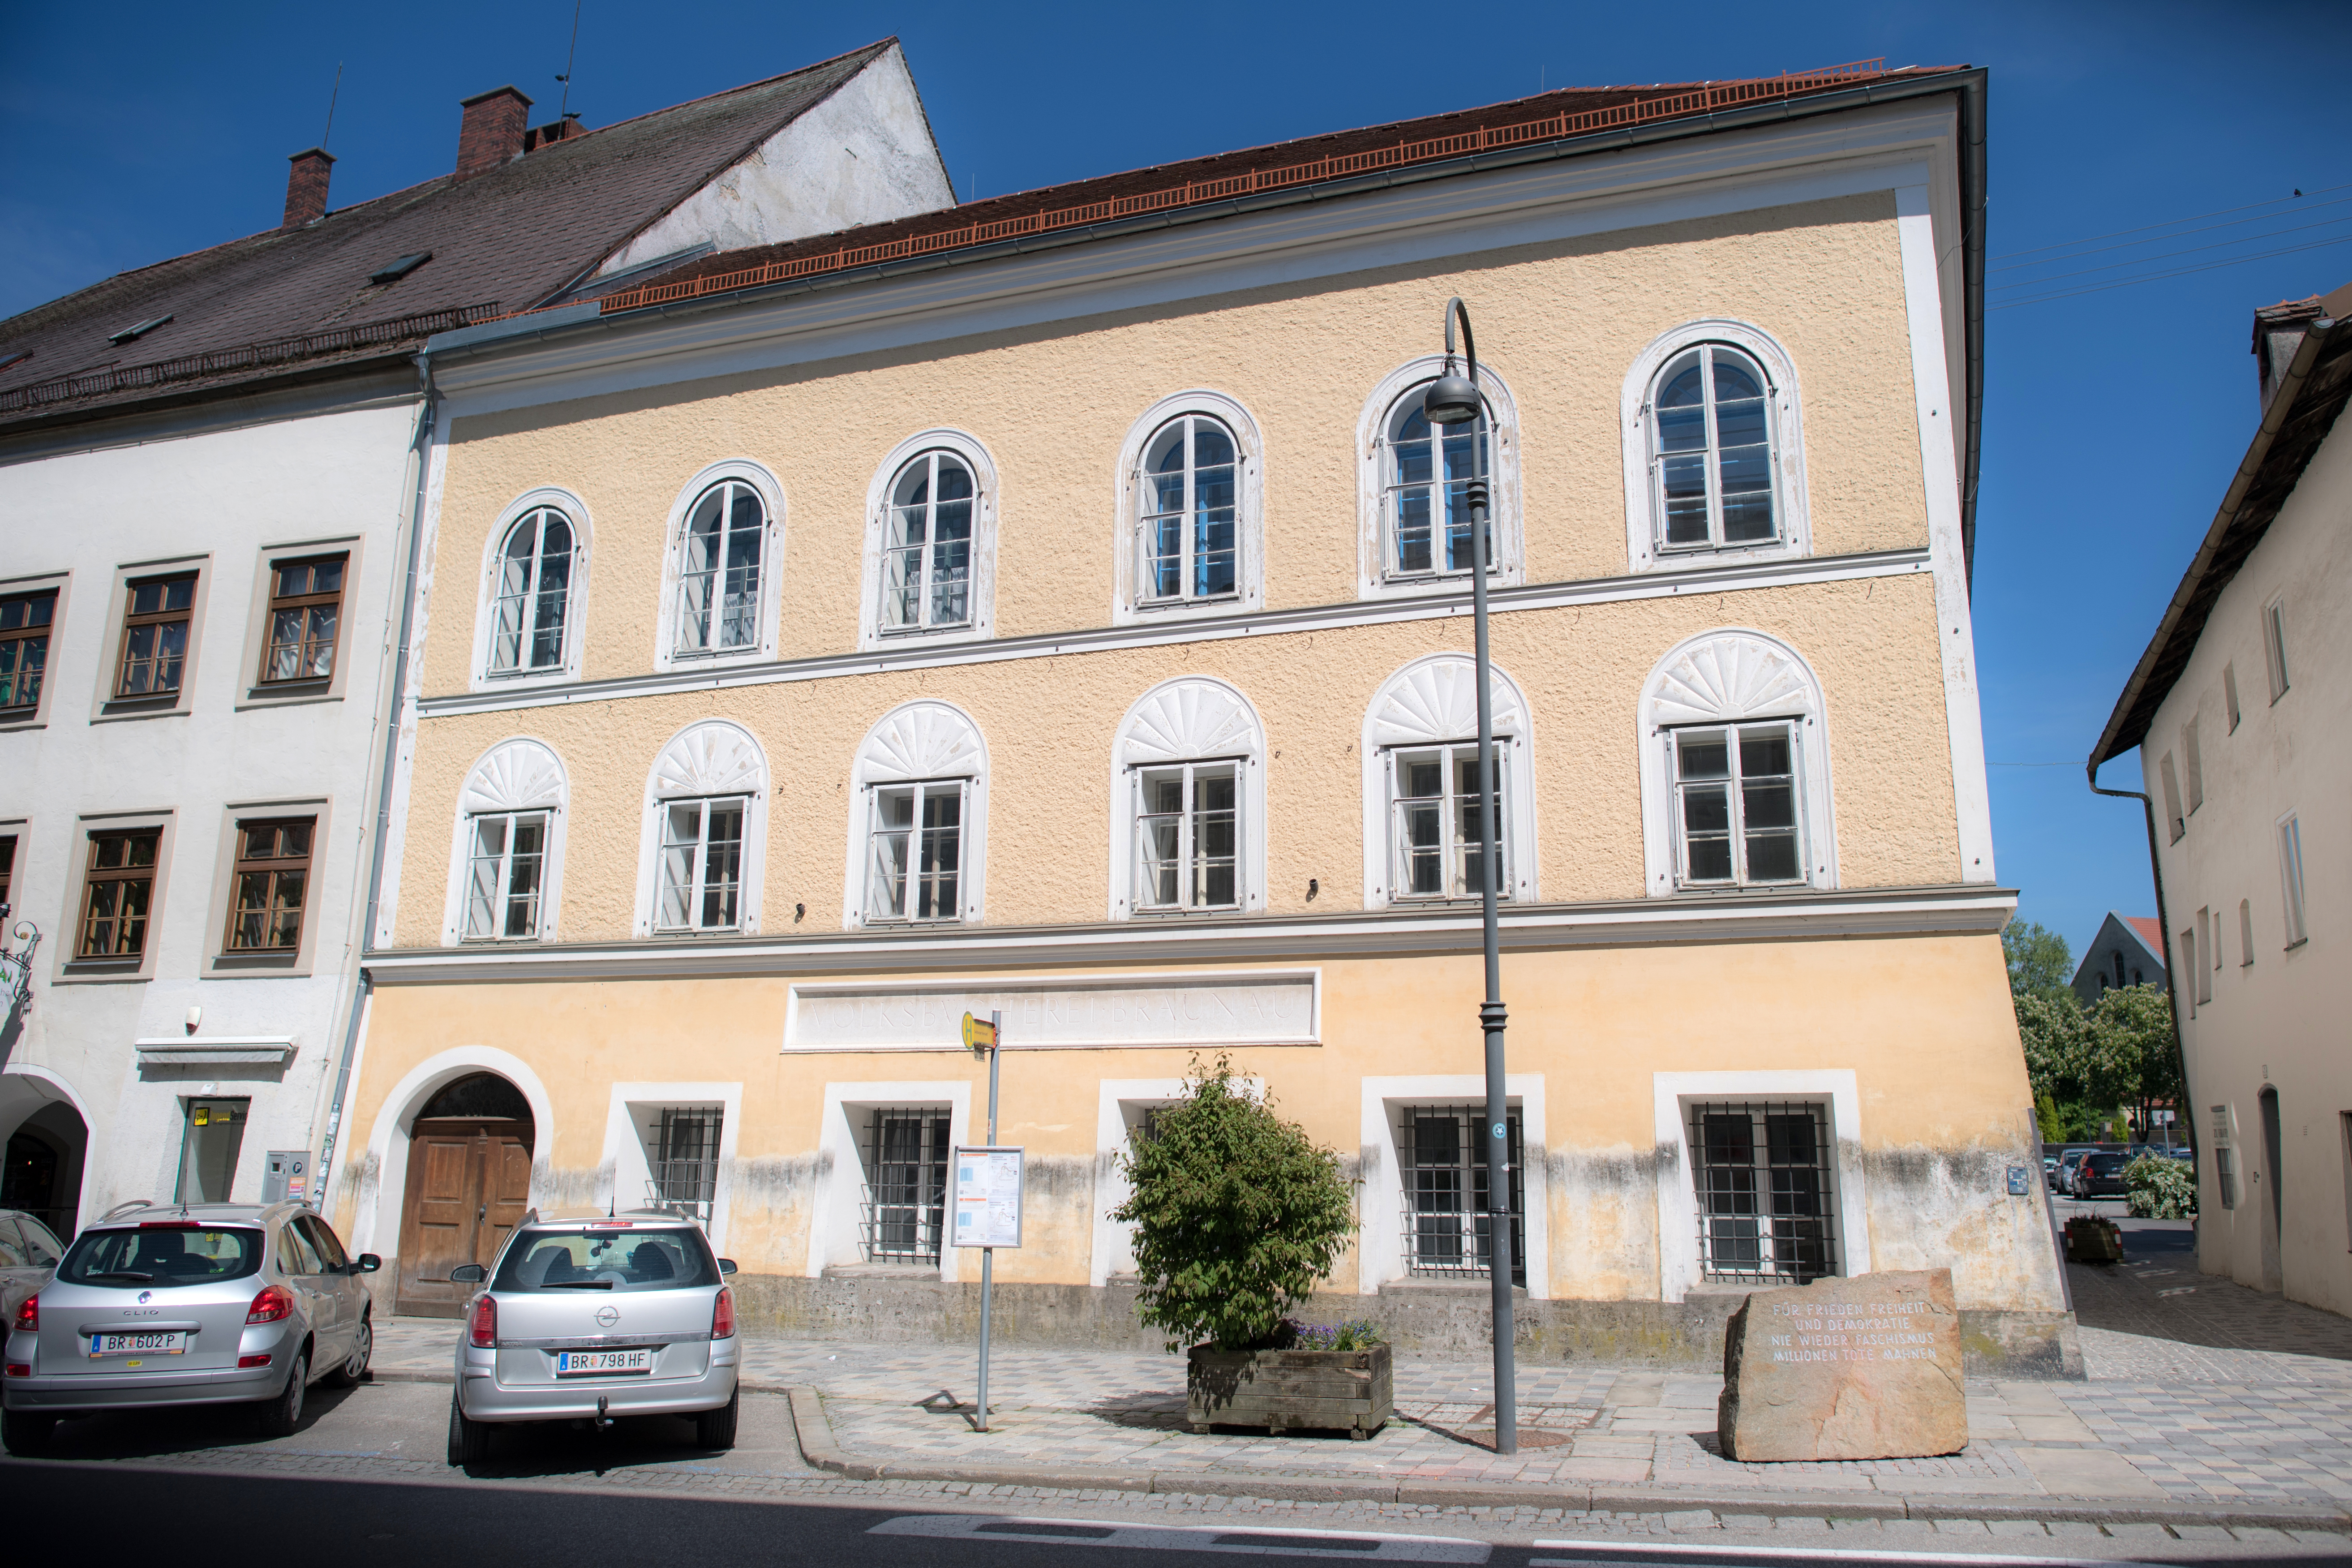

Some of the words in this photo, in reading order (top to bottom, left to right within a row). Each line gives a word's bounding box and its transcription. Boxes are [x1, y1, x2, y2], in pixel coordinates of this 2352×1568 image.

[966, 1018, 972, 1042] H
[294, 1163, 302, 1172] P
[1773, 1302, 1801, 1315] FÜR
[1807, 1303, 1863, 1315] FRIEDEN
[1871, 1302, 1925, 1314] FREIHEIT
[1795, 1319, 1821, 1330] UND
[1828, 1317, 1910, 1331] DEMOKRATIE
[108, 1336, 126, 1349] BR
[137, 1335, 163, 1348] 602
[167, 1334, 175, 1347] P
[1771, 1334, 1791, 1346] NIE
[1798, 1334, 1849, 1346] WIEDER
[1856, 1332, 1934, 1345] FASCHISMUS
[572, 1355, 588, 1369] BR
[600, 1353, 625, 1367] 798
[629, 1353, 645, 1366] HF
[1773, 1349, 1837, 1361] MILLIONEN
[1842, 1349, 1874, 1361] TOTE
[1884, 1347, 1936, 1359] MAHNEN
